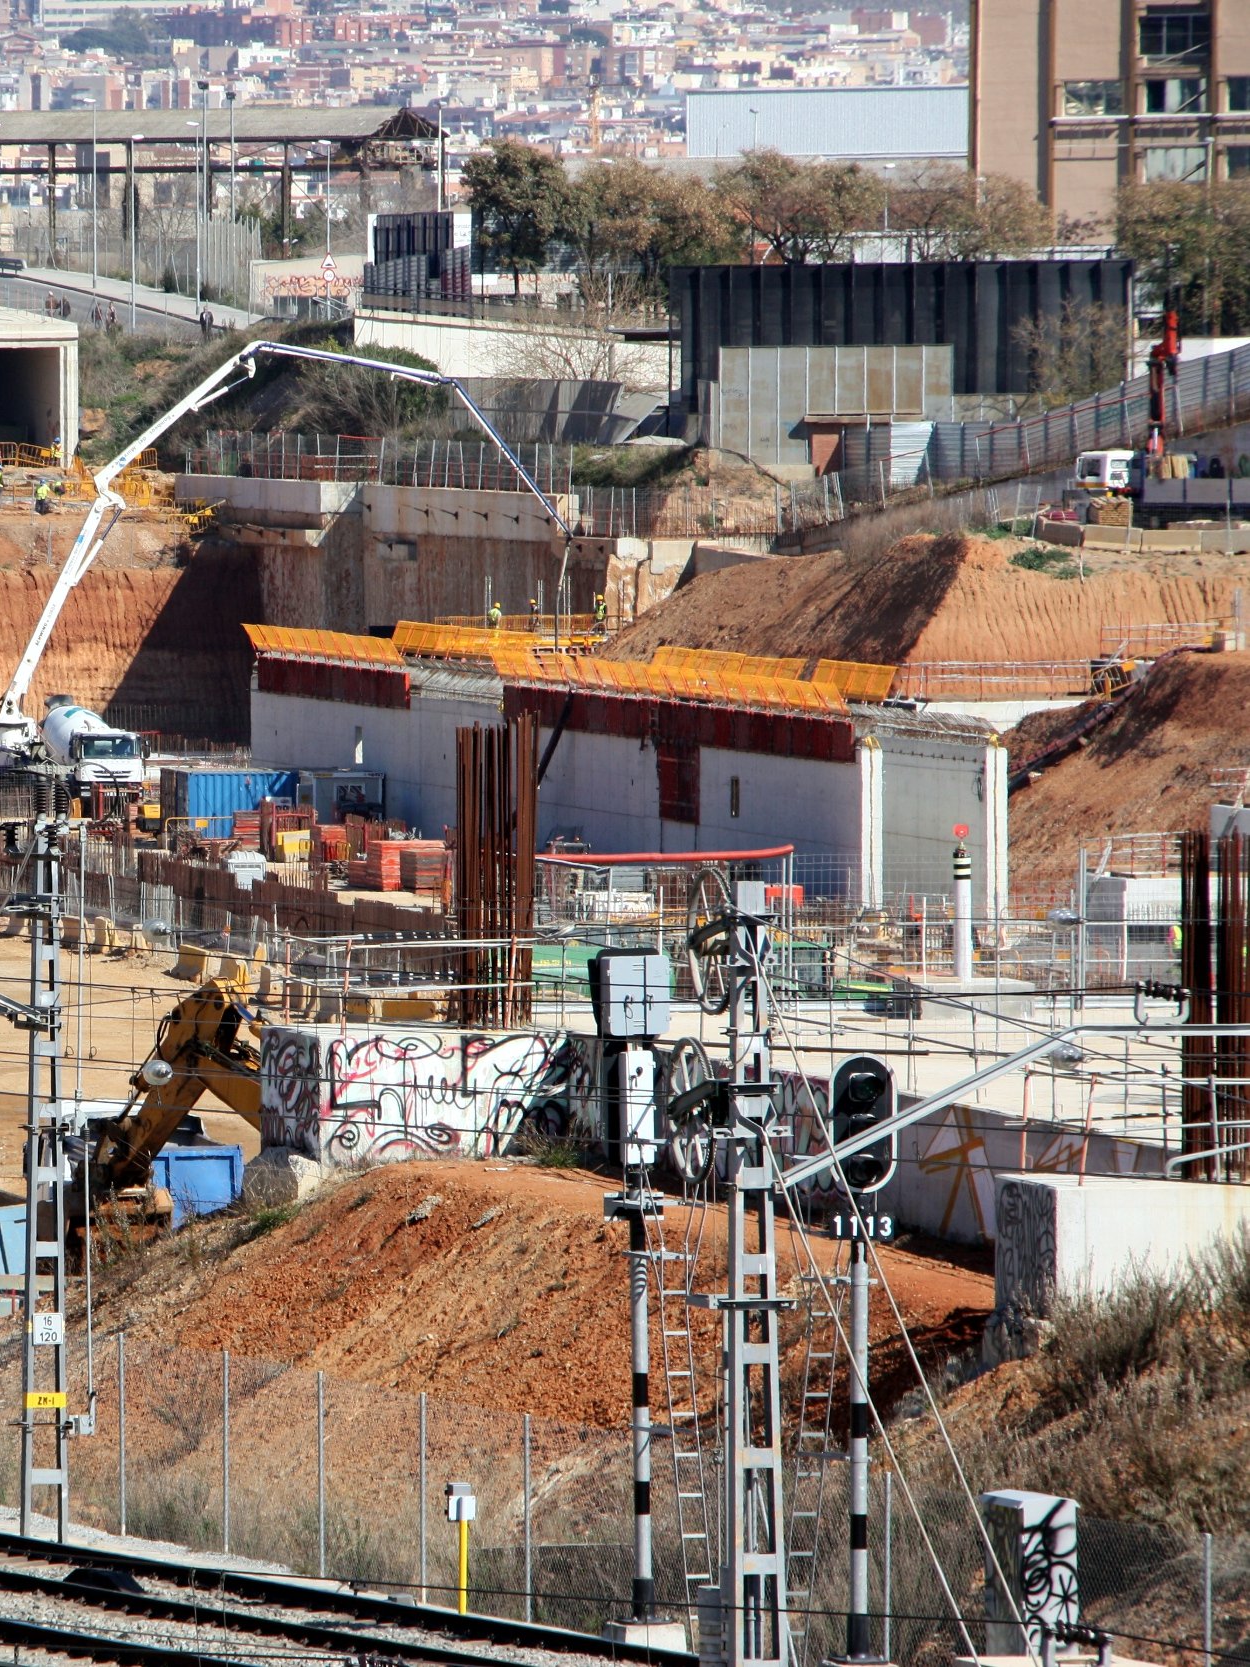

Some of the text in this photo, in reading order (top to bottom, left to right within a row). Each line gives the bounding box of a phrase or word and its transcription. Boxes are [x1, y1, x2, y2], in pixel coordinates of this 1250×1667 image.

[833, 1215, 892, 1237] 1113
[43, 1316, 53, 1327] 16
[39, 1331, 58, 1342] 120
